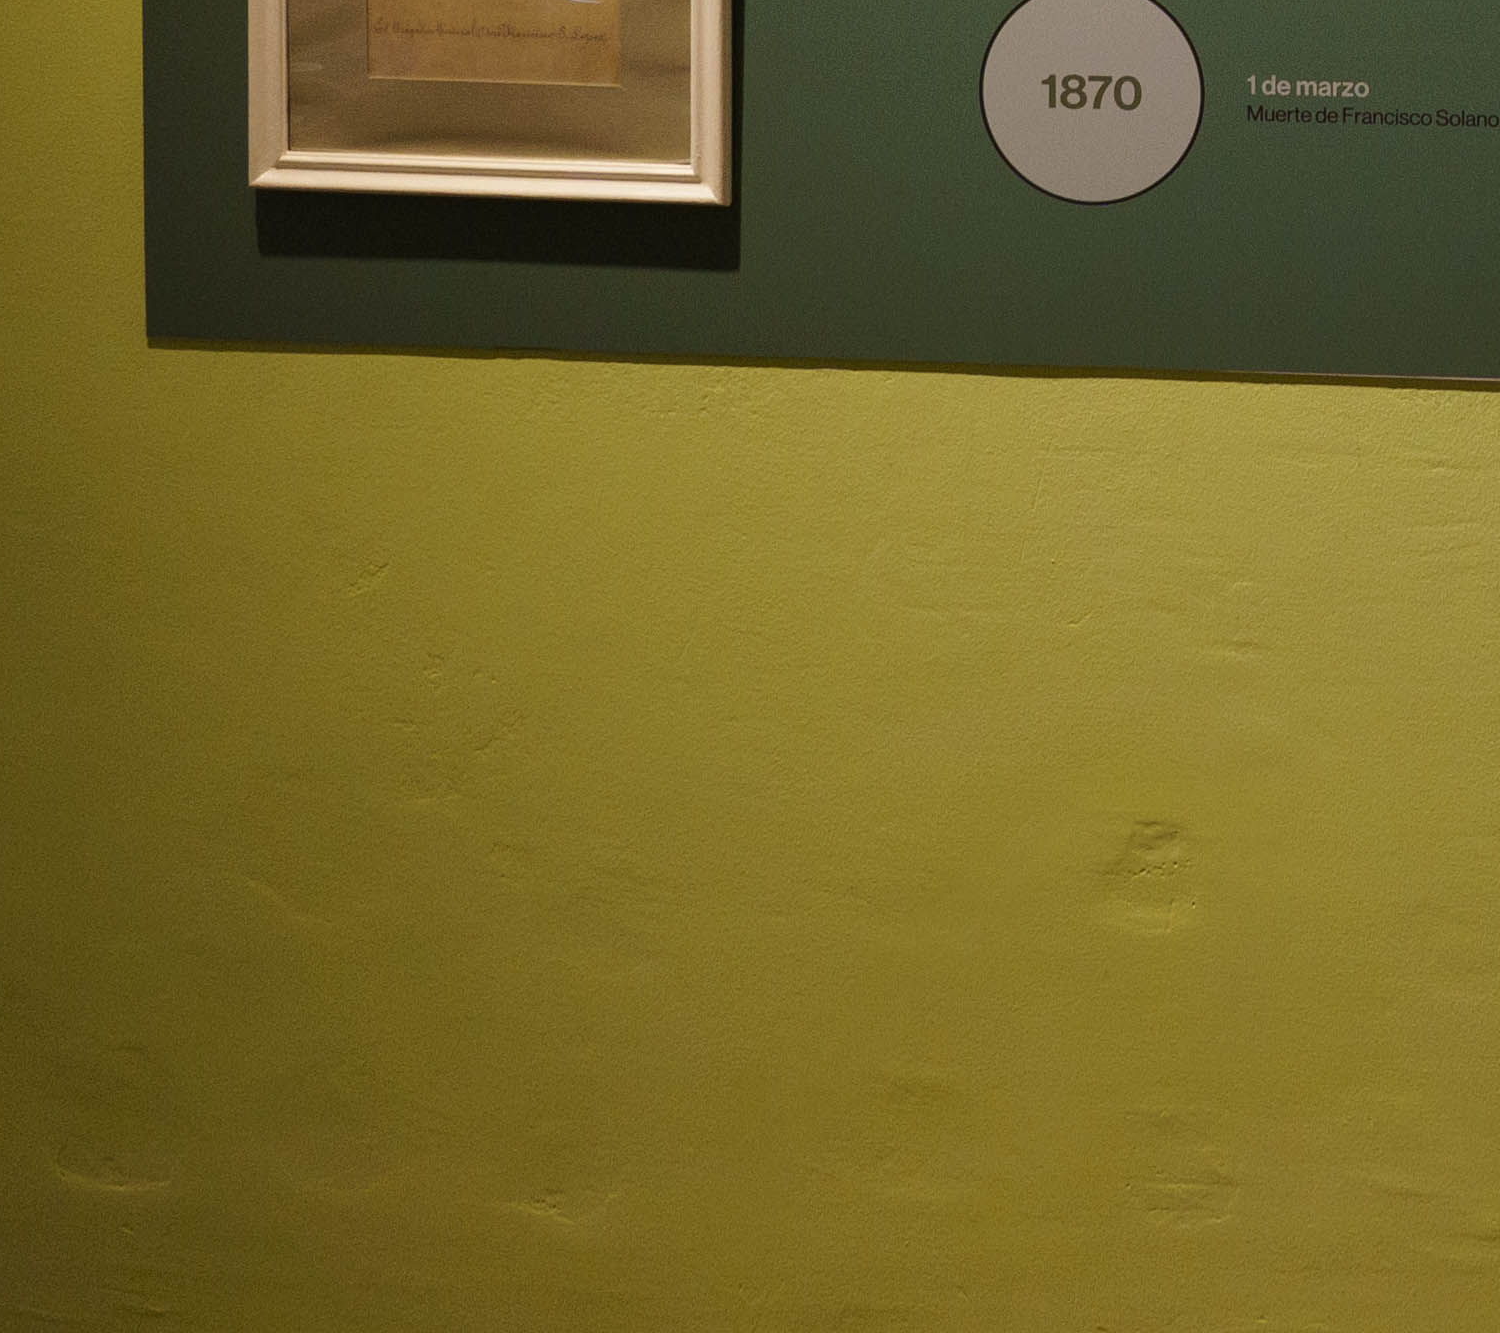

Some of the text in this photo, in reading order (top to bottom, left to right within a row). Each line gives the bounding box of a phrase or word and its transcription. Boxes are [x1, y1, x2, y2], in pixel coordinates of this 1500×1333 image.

[1040, 73, 1143, 112] 1870
[1246, 74, 1370, 98] 1 de marzo
[1246, 104, 1313, 124] Muerte
[1314, 106, 1339, 124] de
[1341, 106, 1433, 127] Francisco
[1435, 108, 1500, 128] Solano
